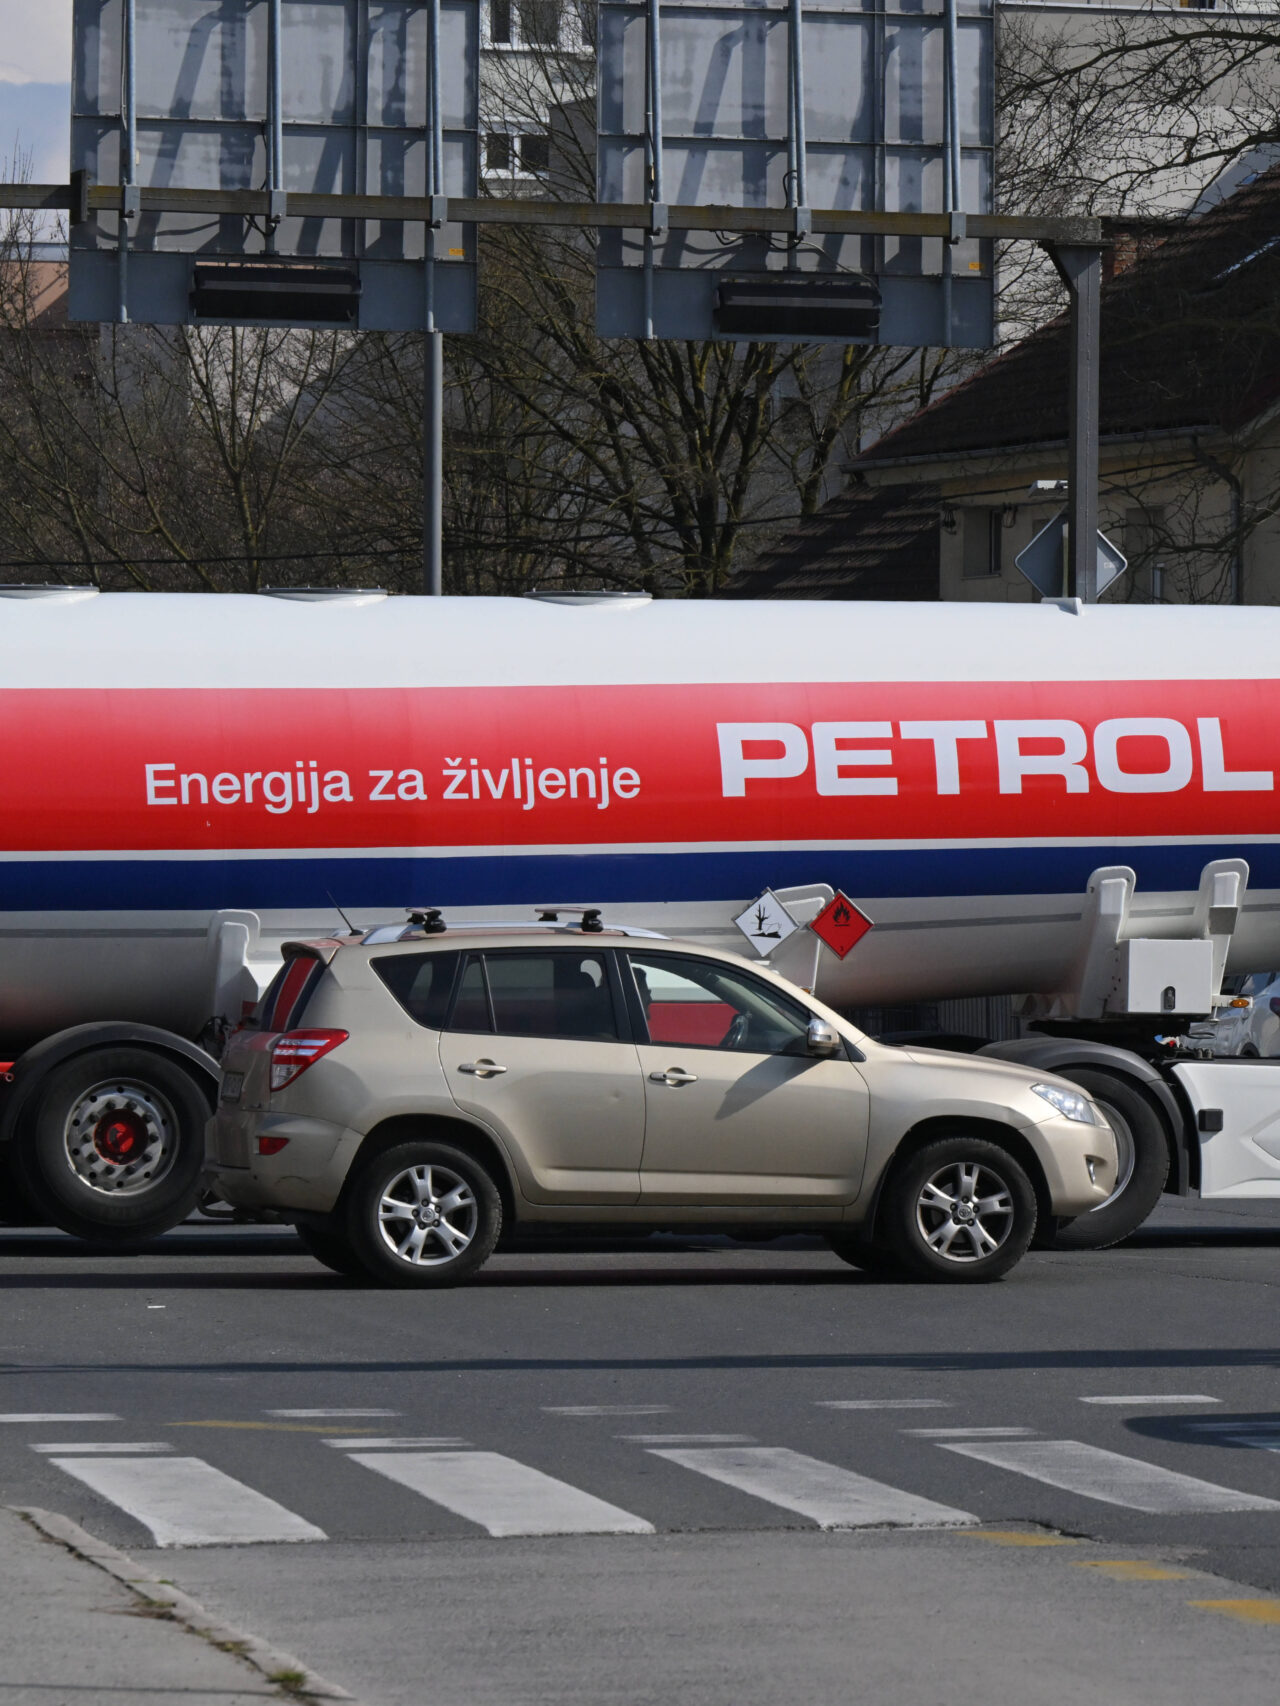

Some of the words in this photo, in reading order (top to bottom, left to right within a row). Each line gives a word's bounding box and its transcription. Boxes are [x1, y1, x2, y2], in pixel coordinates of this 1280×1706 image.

[145, 760, 353, 814] Energija
[368, 766, 427, 801] za
[442, 757, 641, 810] življenje
[716, 717, 1274, 798] PETROL
